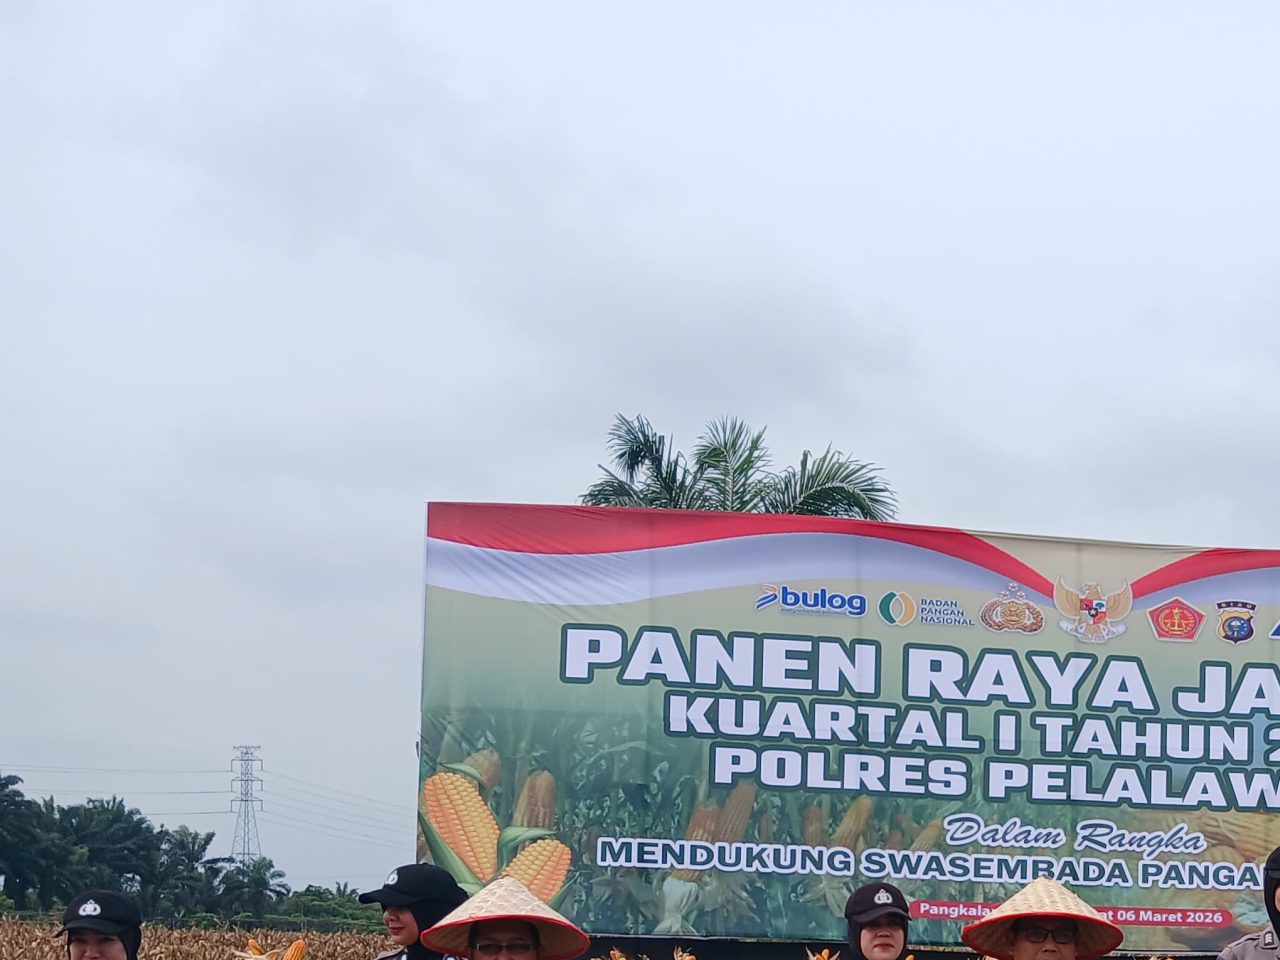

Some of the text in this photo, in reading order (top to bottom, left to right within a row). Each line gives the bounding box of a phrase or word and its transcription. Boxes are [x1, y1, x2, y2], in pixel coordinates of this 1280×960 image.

[781, 586, 866, 616] bulog
[920, 598, 958, 608] BADAN
[920, 607, 964, 617] PANGAN
[920, 616, 975, 626] NASIONAL
[564, 628, 877, 695] PANEN
[906, 647, 1156, 711] RAYA
[669, 695, 981, 749] KUARTAL
[998, 714, 1017, 751] I
[1034, 715, 1249, 761] TAHUN
[713, 746, 967, 796] POLRES
[946, 815, 1206, 858] Dalam Rangka
[599, 840, 852, 873] MENDUKUNG
[863, 851, 1130, 885] SWASEMBADA
[1141, 863, 1264, 888] PANGA
[919, 902, 991, 918] Pangkala
[1117, 910, 1136, 921] 06
[1139, 910, 1183, 922] Maret
[1185, 911, 1224, 923] 2026
